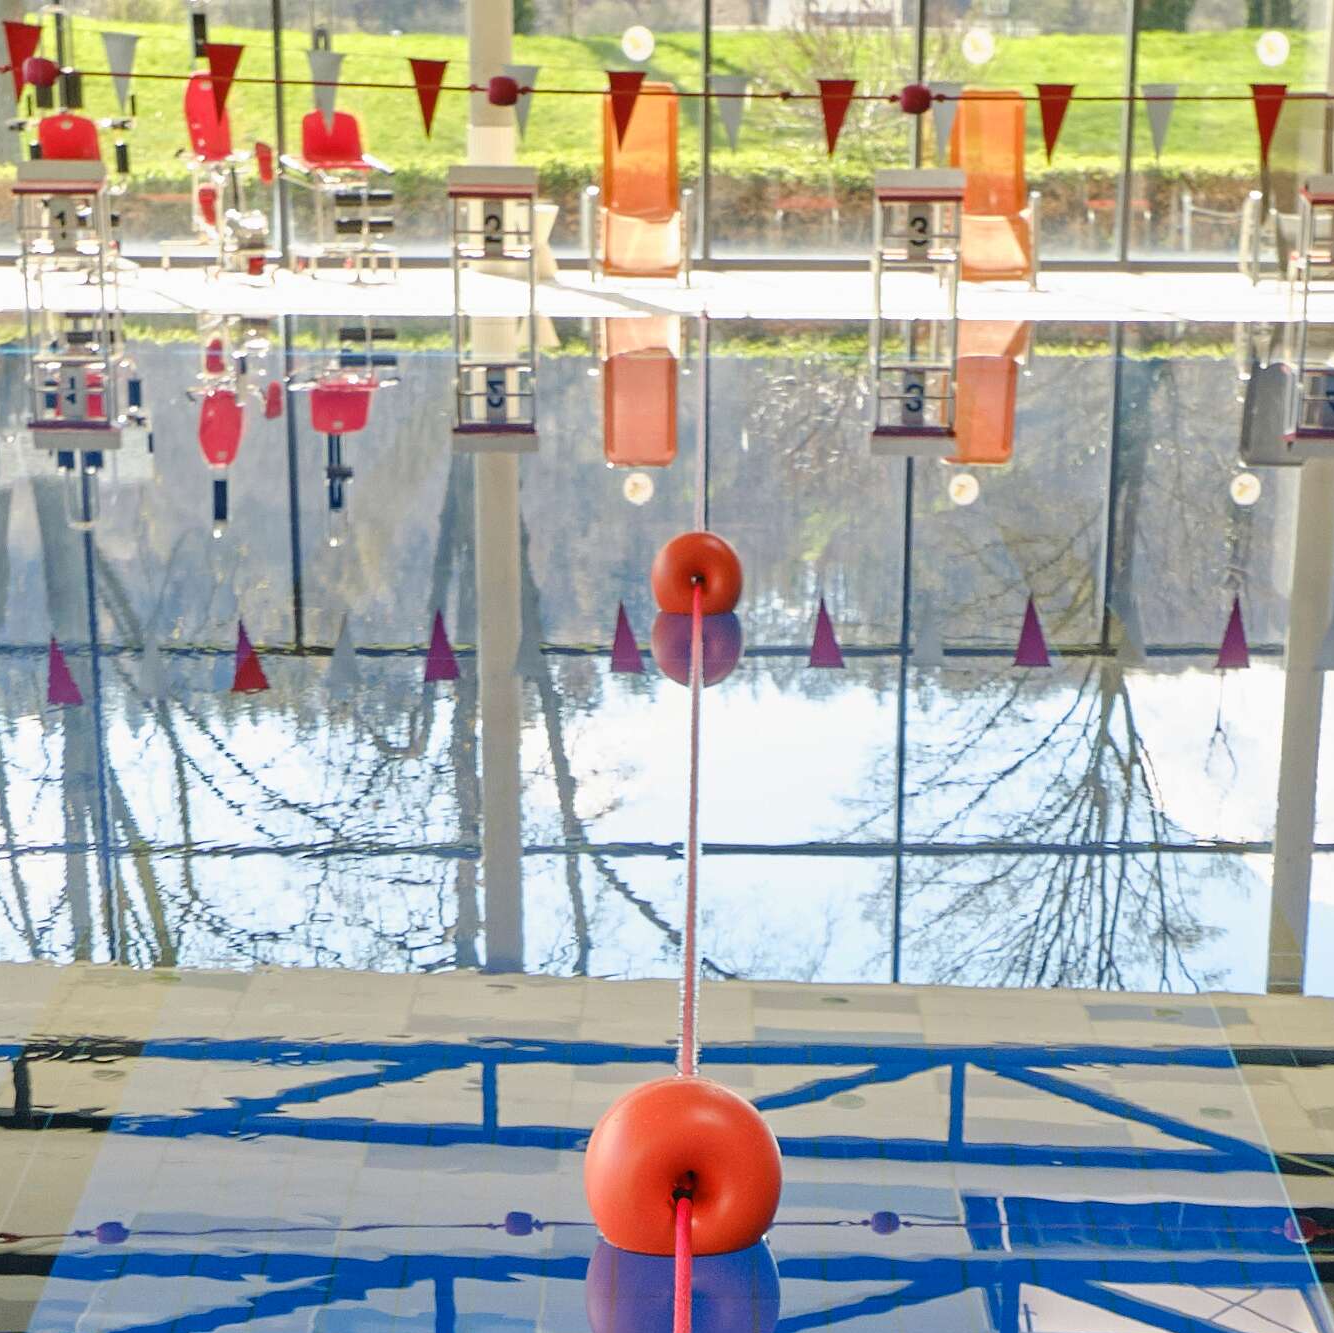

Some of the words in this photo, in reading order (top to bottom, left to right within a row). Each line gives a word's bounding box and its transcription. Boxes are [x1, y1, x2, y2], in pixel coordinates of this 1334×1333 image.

[55, 211, 66, 239] 1
[485, 215, 501, 242] 2
[910, 217, 928, 246] 3
